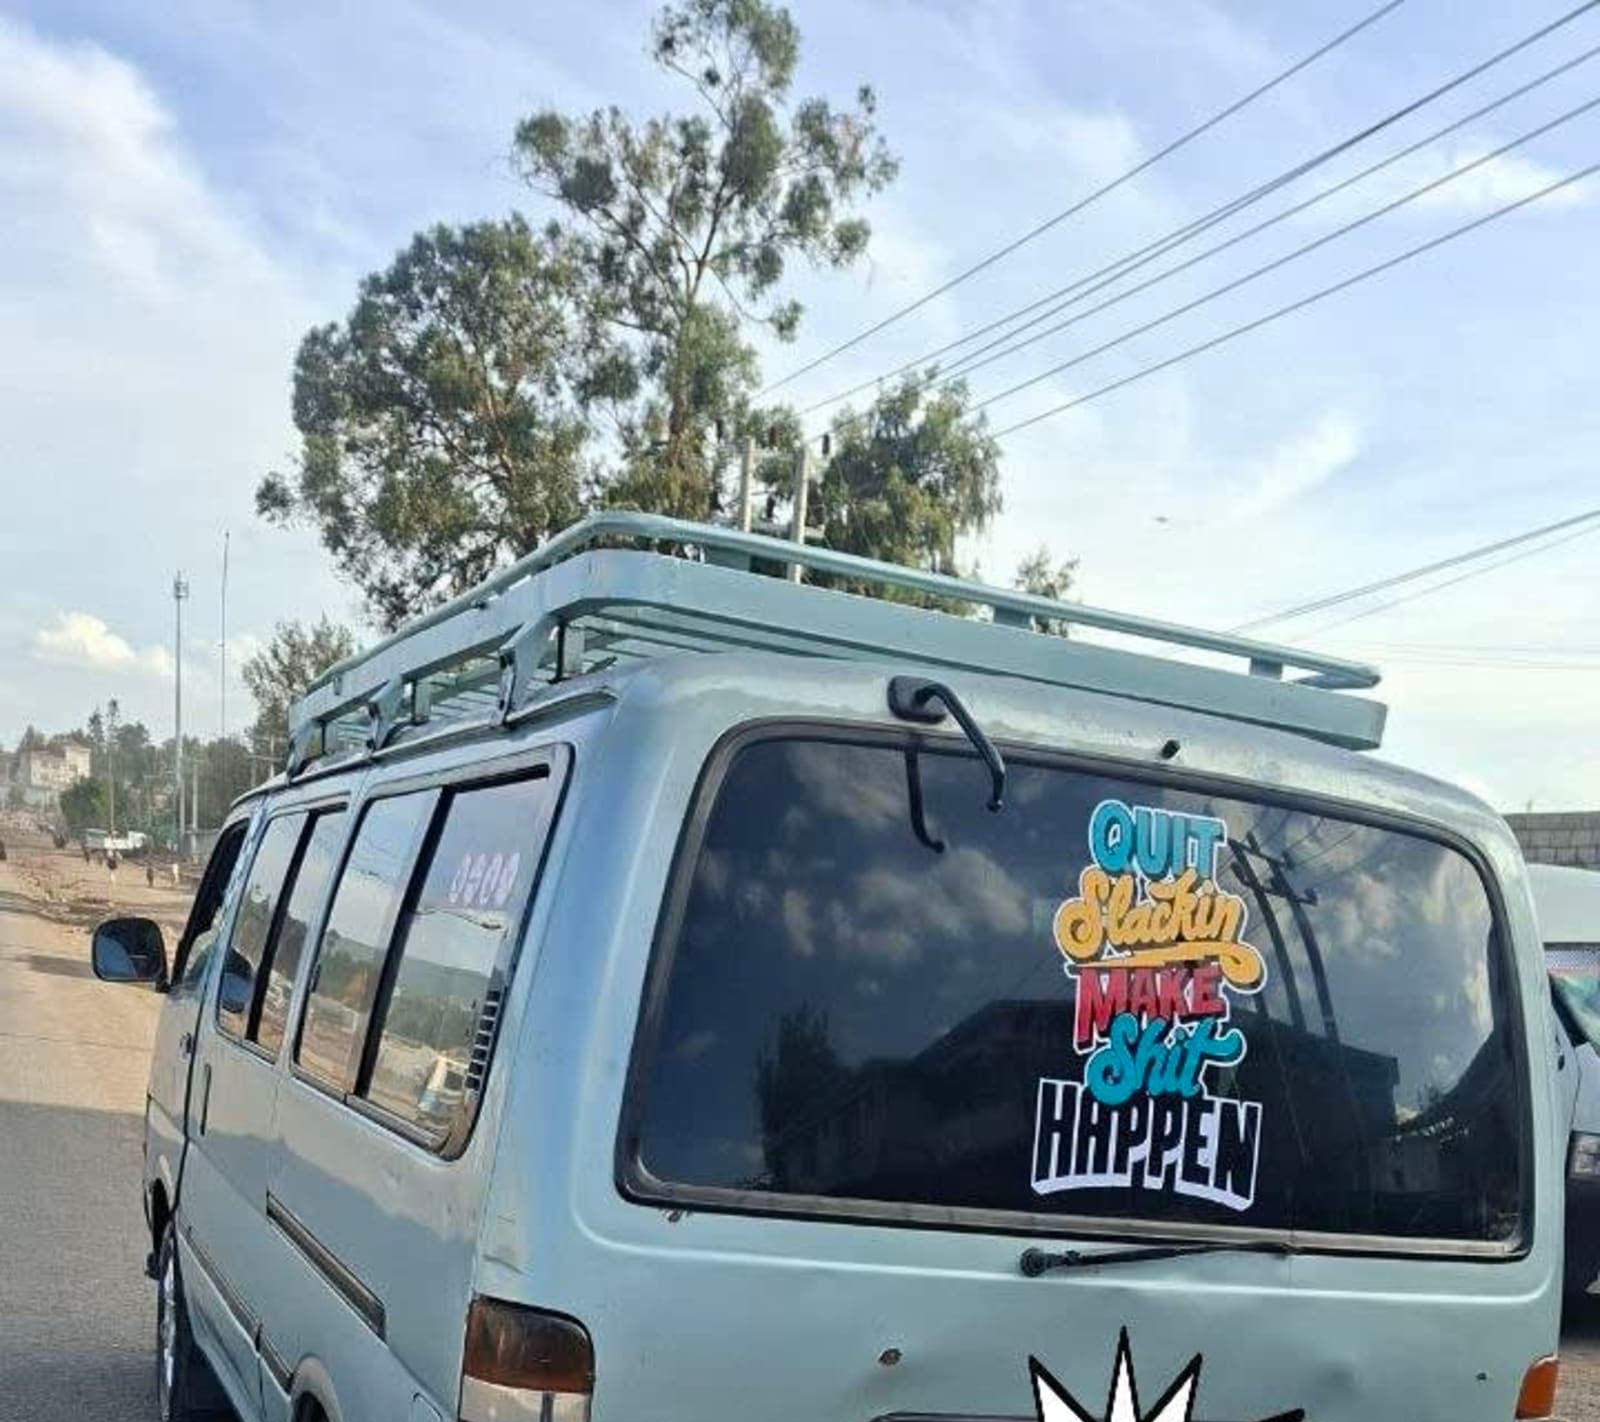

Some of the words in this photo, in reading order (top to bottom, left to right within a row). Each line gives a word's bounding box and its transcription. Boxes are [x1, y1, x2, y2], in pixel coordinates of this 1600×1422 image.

[1090, 799, 1227, 880] QUIT
[1055, 866, 1265, 988] Slackin
[1074, 964, 1229, 1050] MAKE
[1087, 1012, 1246, 1104] Shit
[1031, 1078, 1262, 1211] HAPPEN
